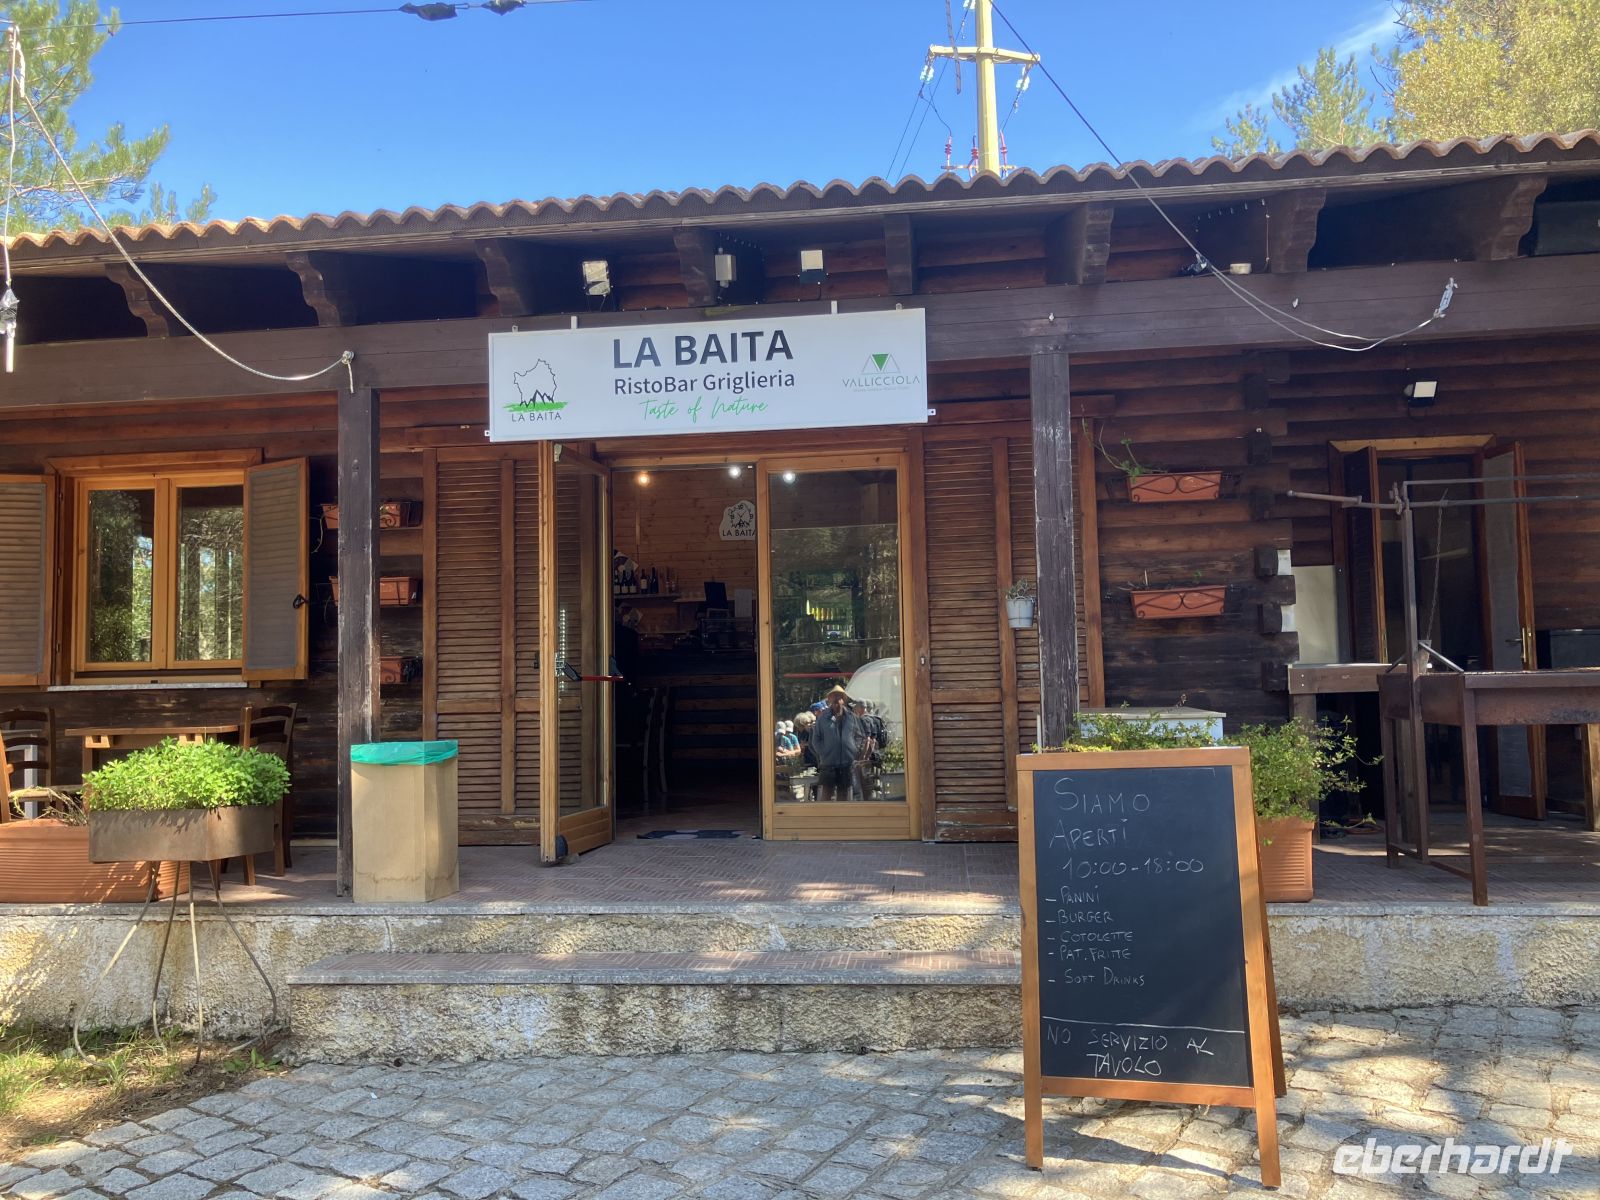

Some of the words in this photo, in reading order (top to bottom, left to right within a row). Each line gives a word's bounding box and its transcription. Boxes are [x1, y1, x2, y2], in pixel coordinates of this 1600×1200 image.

[613, 336, 662, 369] LA
[674, 329, 794, 366] BAITA
[614, 376, 698, 395] RistoBar
[703, 369, 795, 395] Griglieria
[842, 375, 920, 388] VALLICCIOLA
[511, 413, 525, 422] LA
[529, 411, 562, 421] BAITA
[640, 399, 679, 420] Taste
[687, 396, 703, 423] of
[711, 396, 769, 420] Nature
[722, 529, 733, 537] LA
[1047, 1024, 1071, 1045] NO
[1087, 1028, 1168, 1052] SERVIZIO
[1186, 1037, 1215, 1056] AL
[1086, 1052, 1162, 1077] TAVOLO
